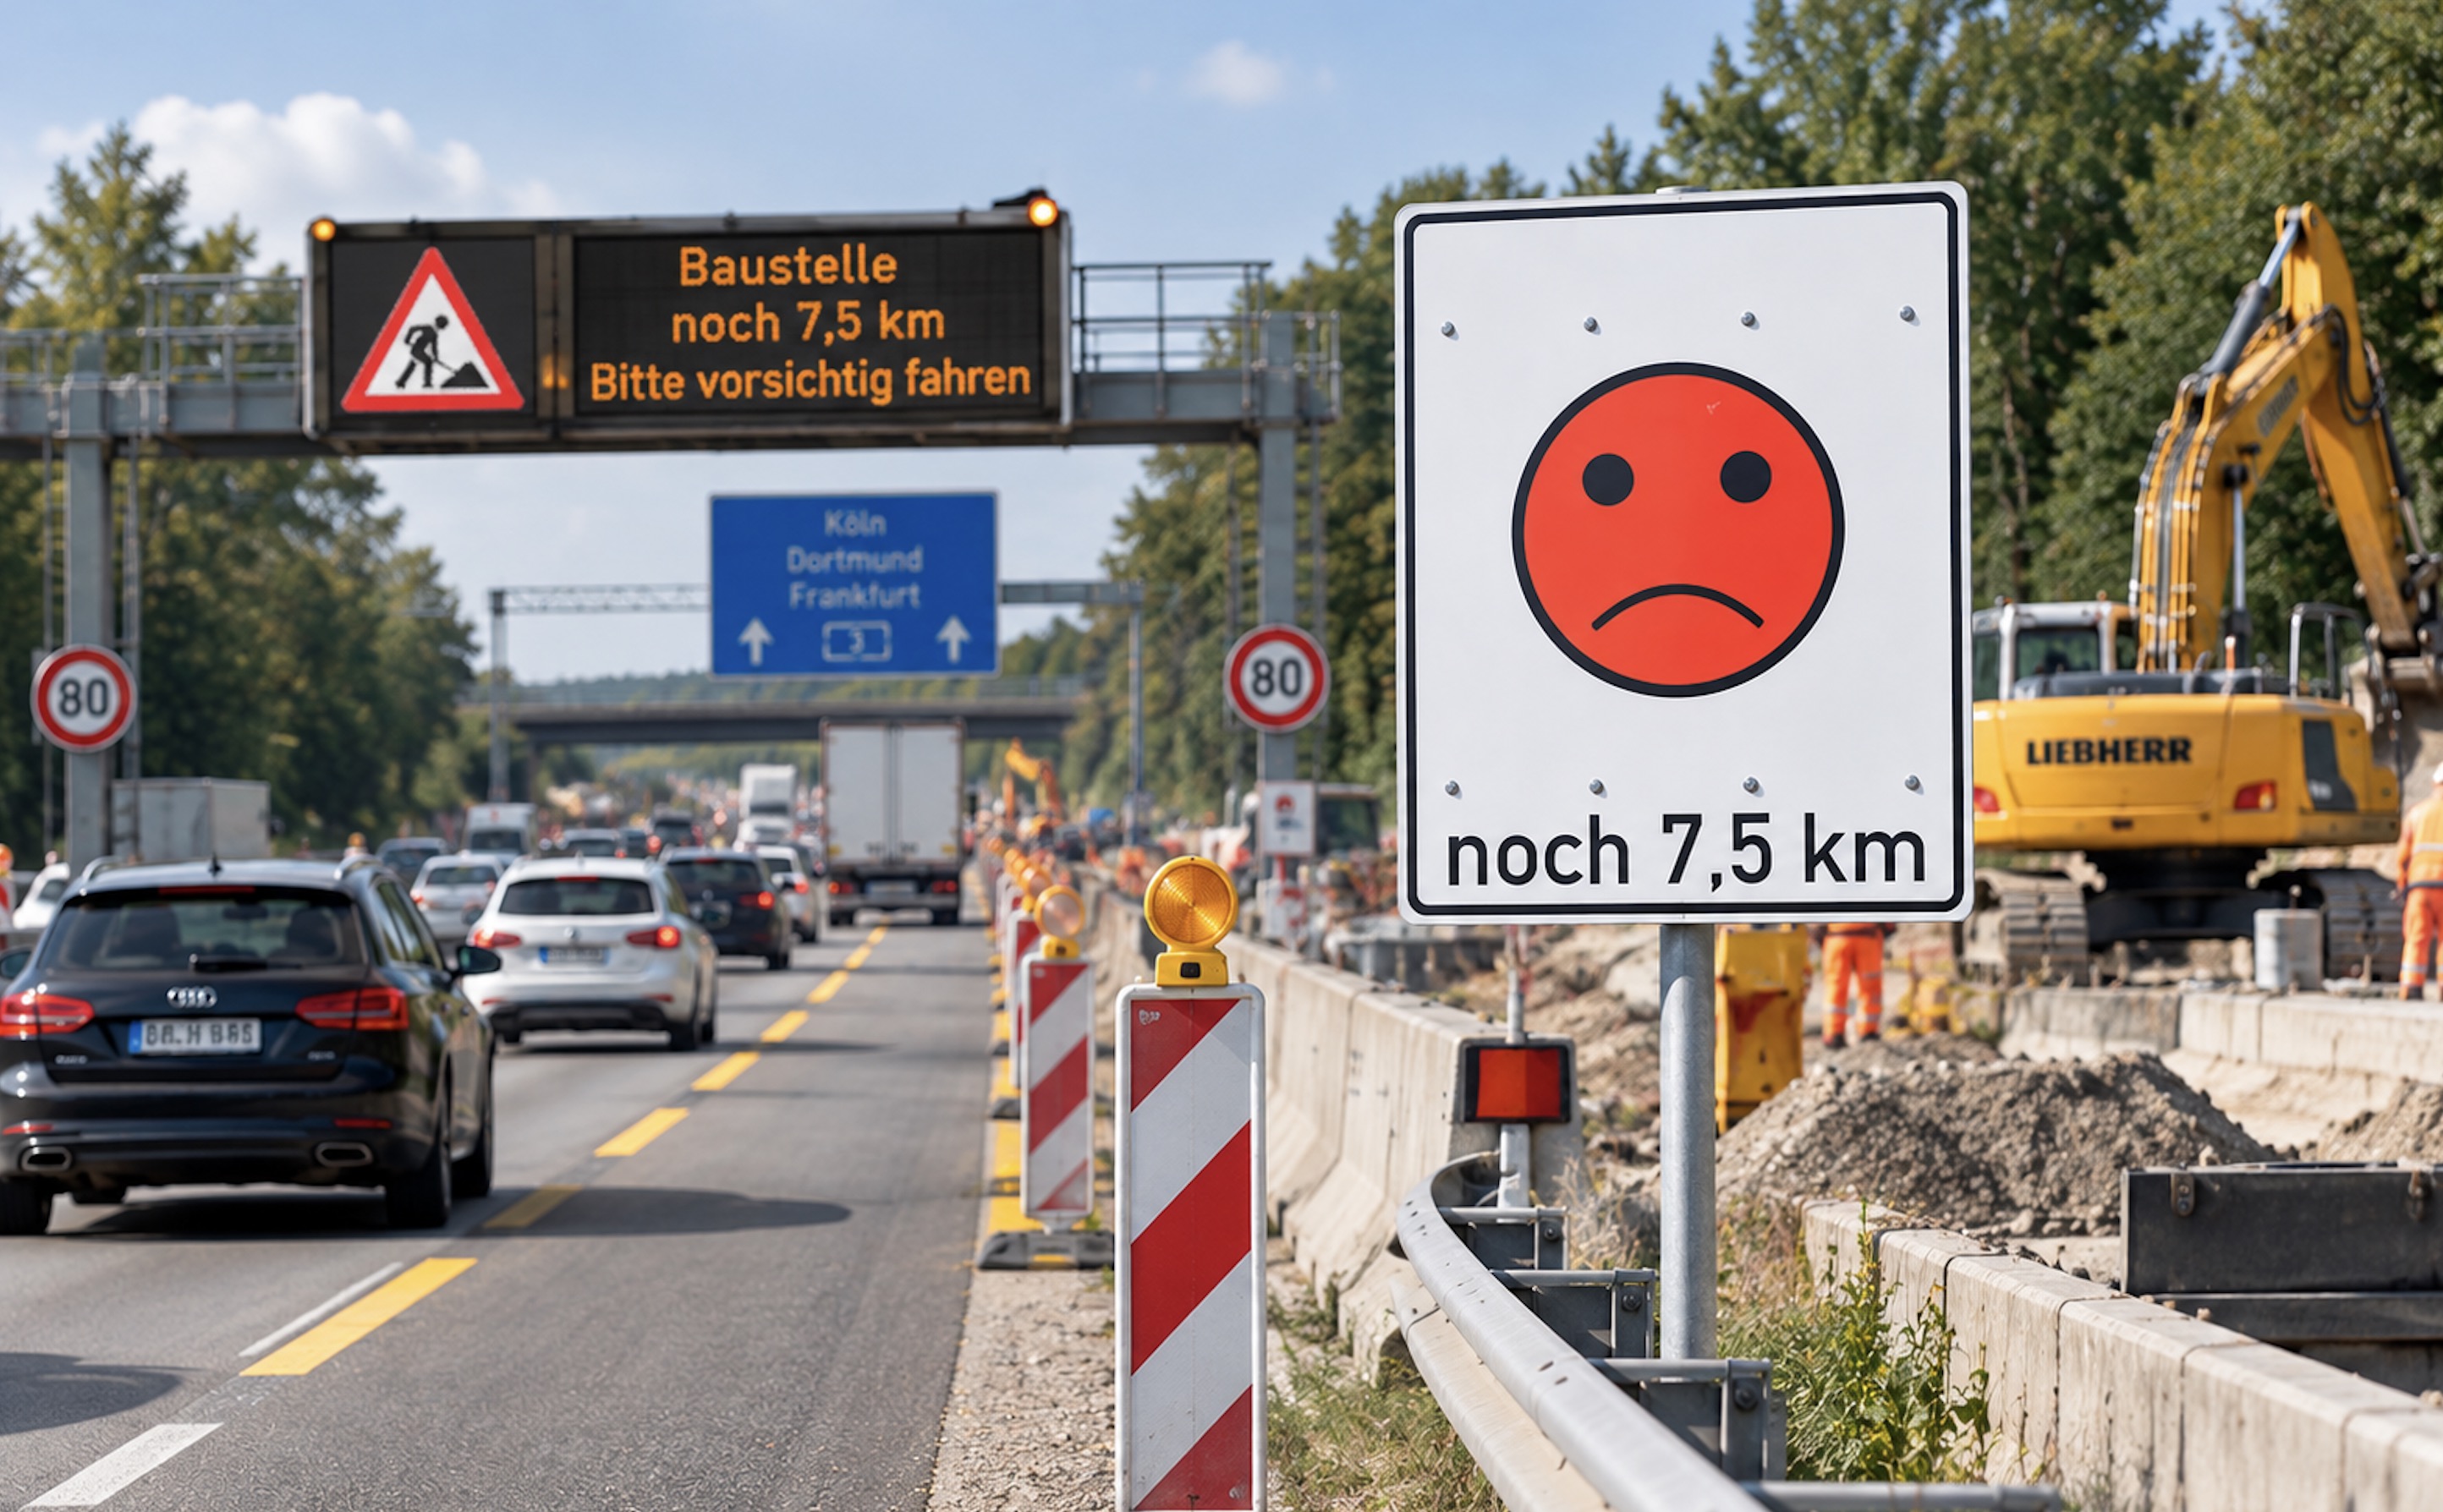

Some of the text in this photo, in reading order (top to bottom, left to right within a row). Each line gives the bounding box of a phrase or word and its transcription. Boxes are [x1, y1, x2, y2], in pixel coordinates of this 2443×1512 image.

[680, 243, 898, 287] Baustelle
[672, 299, 945, 347] noch 7,5 km
[591, 356, 1030, 407] Bitte vorsichtig fahren
[824, 509, 887, 537] Köln
[787, 545, 924, 574] Dortmund
[789, 580, 921, 610] Frankfurt
[59, 678, 109, 718] 80
[1251, 658, 1303, 698] 80
[2027, 737, 2193, 765] LIEBHERR
[1448, 812, 1925, 892] noch 7,5 km
